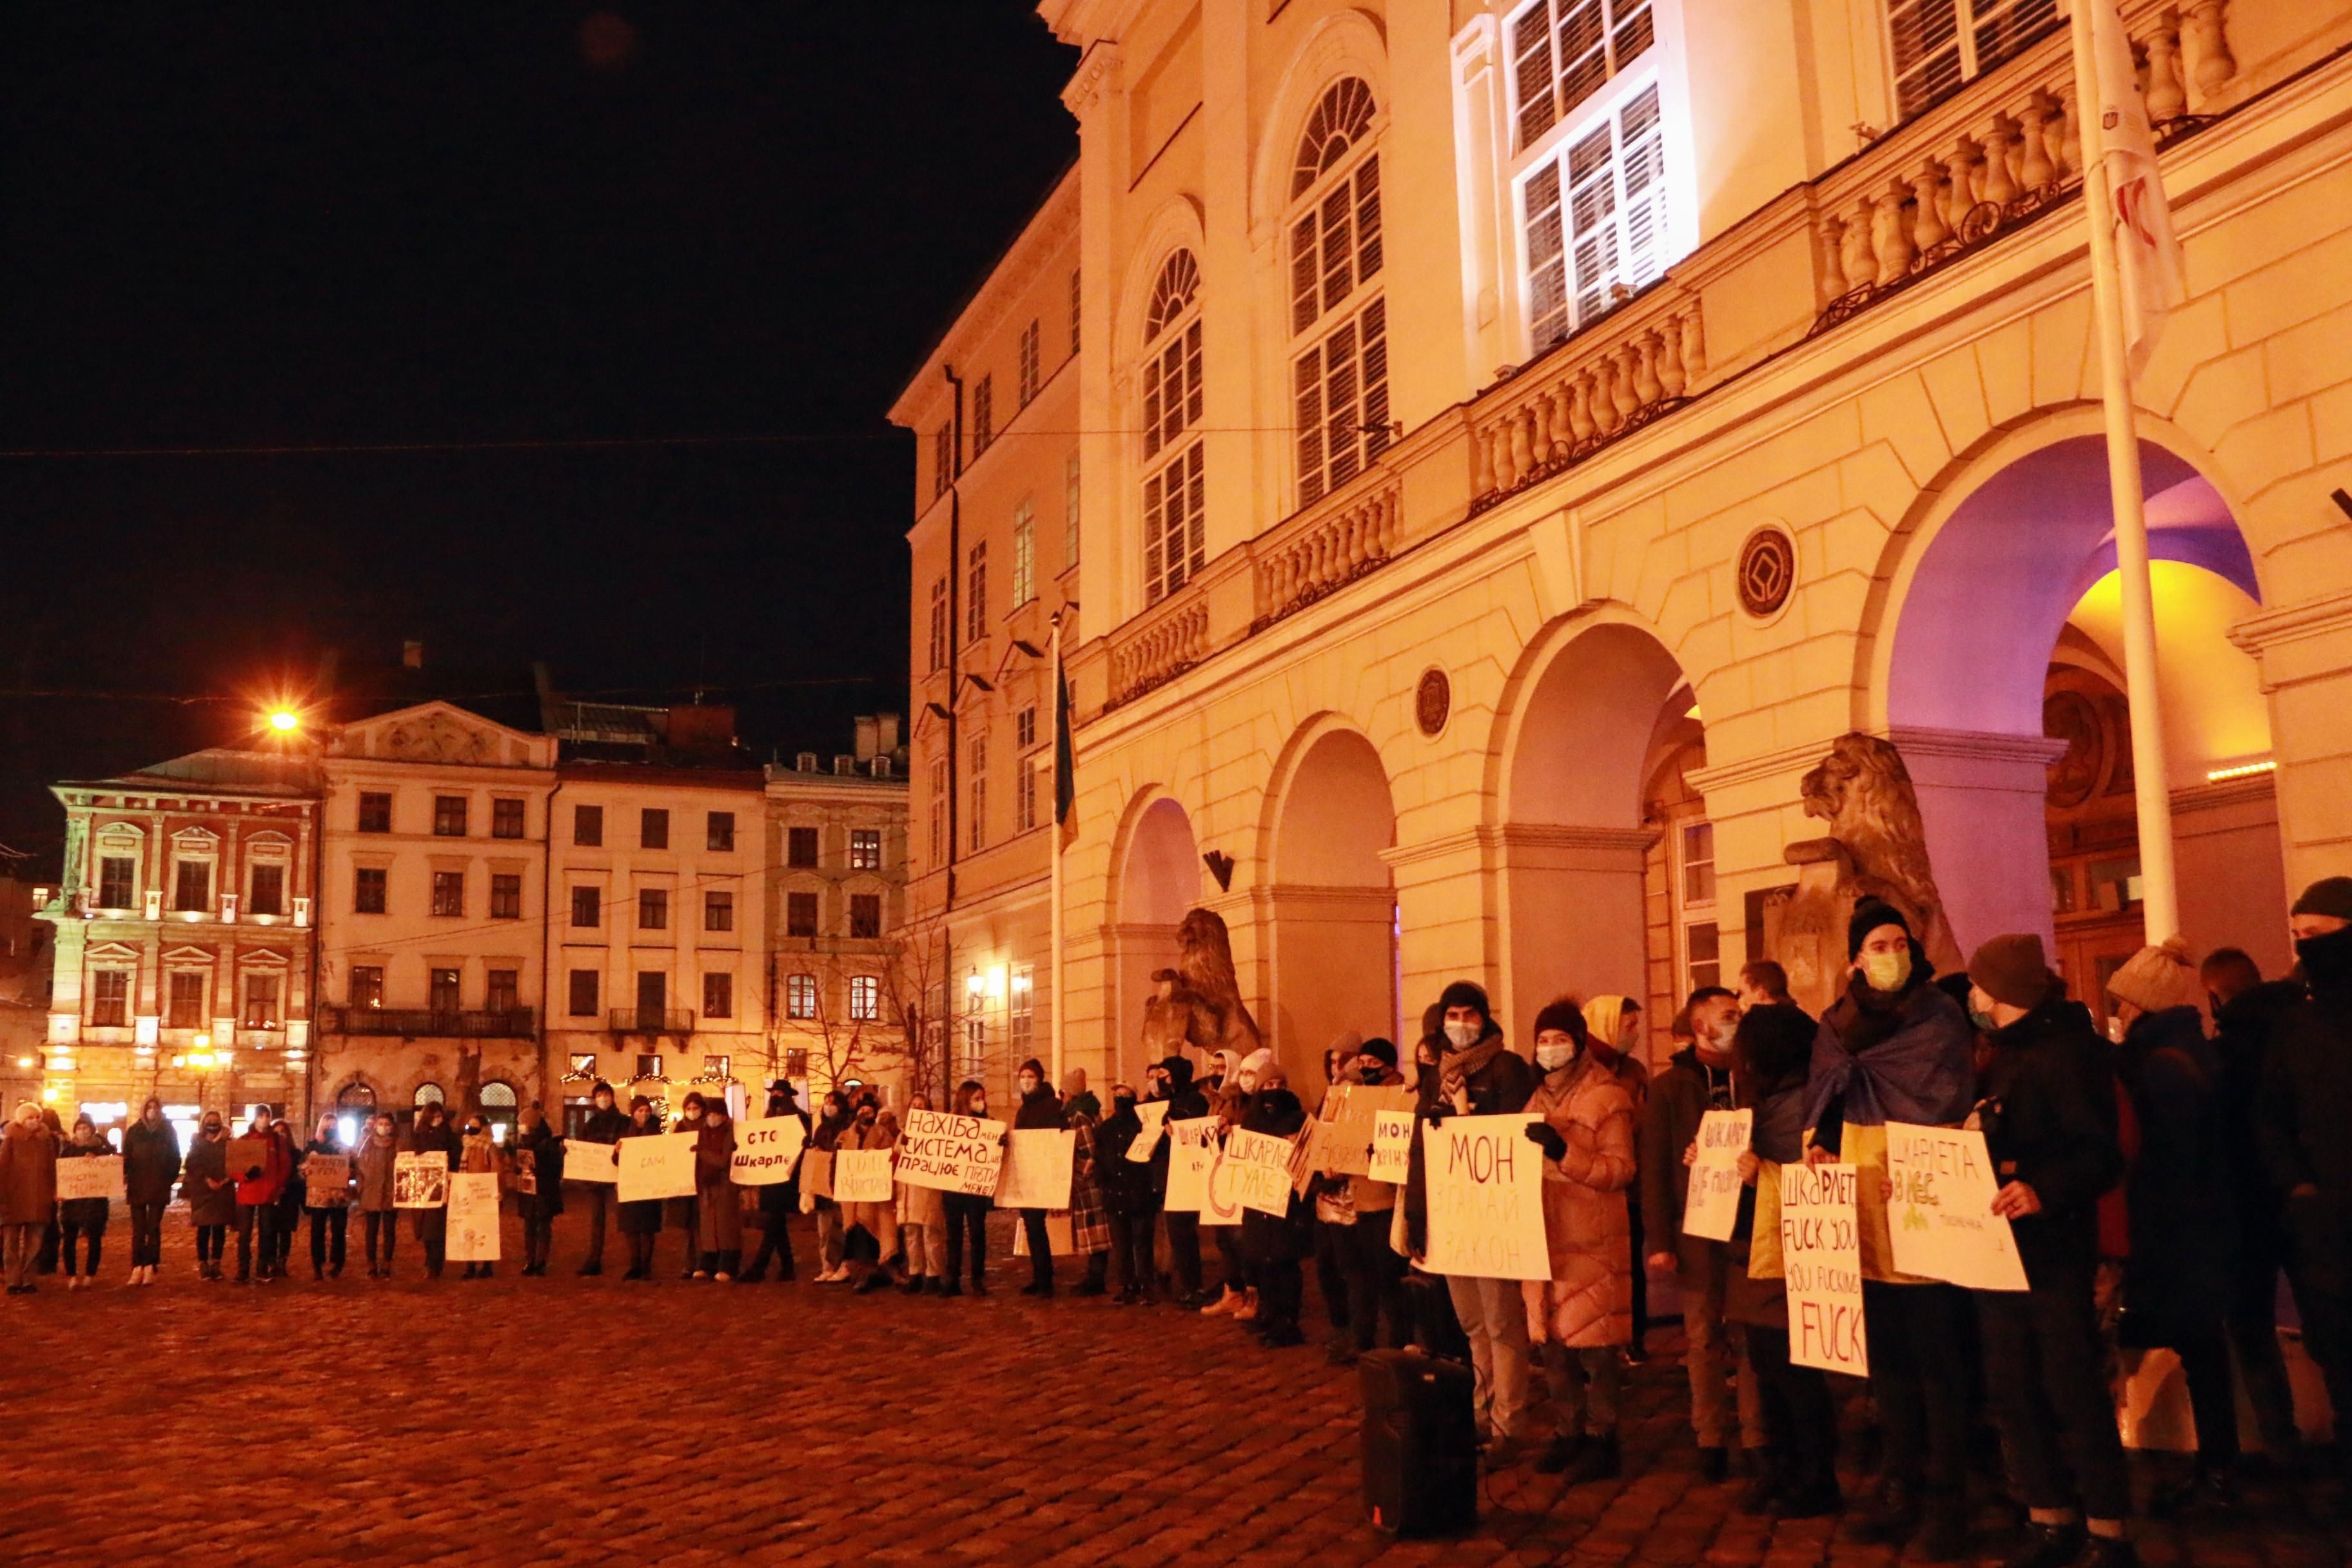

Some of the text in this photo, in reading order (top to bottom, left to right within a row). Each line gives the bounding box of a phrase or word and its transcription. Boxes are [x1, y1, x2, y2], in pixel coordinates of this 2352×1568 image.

[1378, 1123, 1410, 1139] МОН
[1447, 1132, 1514, 1185] МОН
[1783, 1216, 1857, 1253] FUCK YOU
[1785, 1262, 1859, 1295] YOU FUCKING
[1801, 1300, 1865, 1367] FUCK
